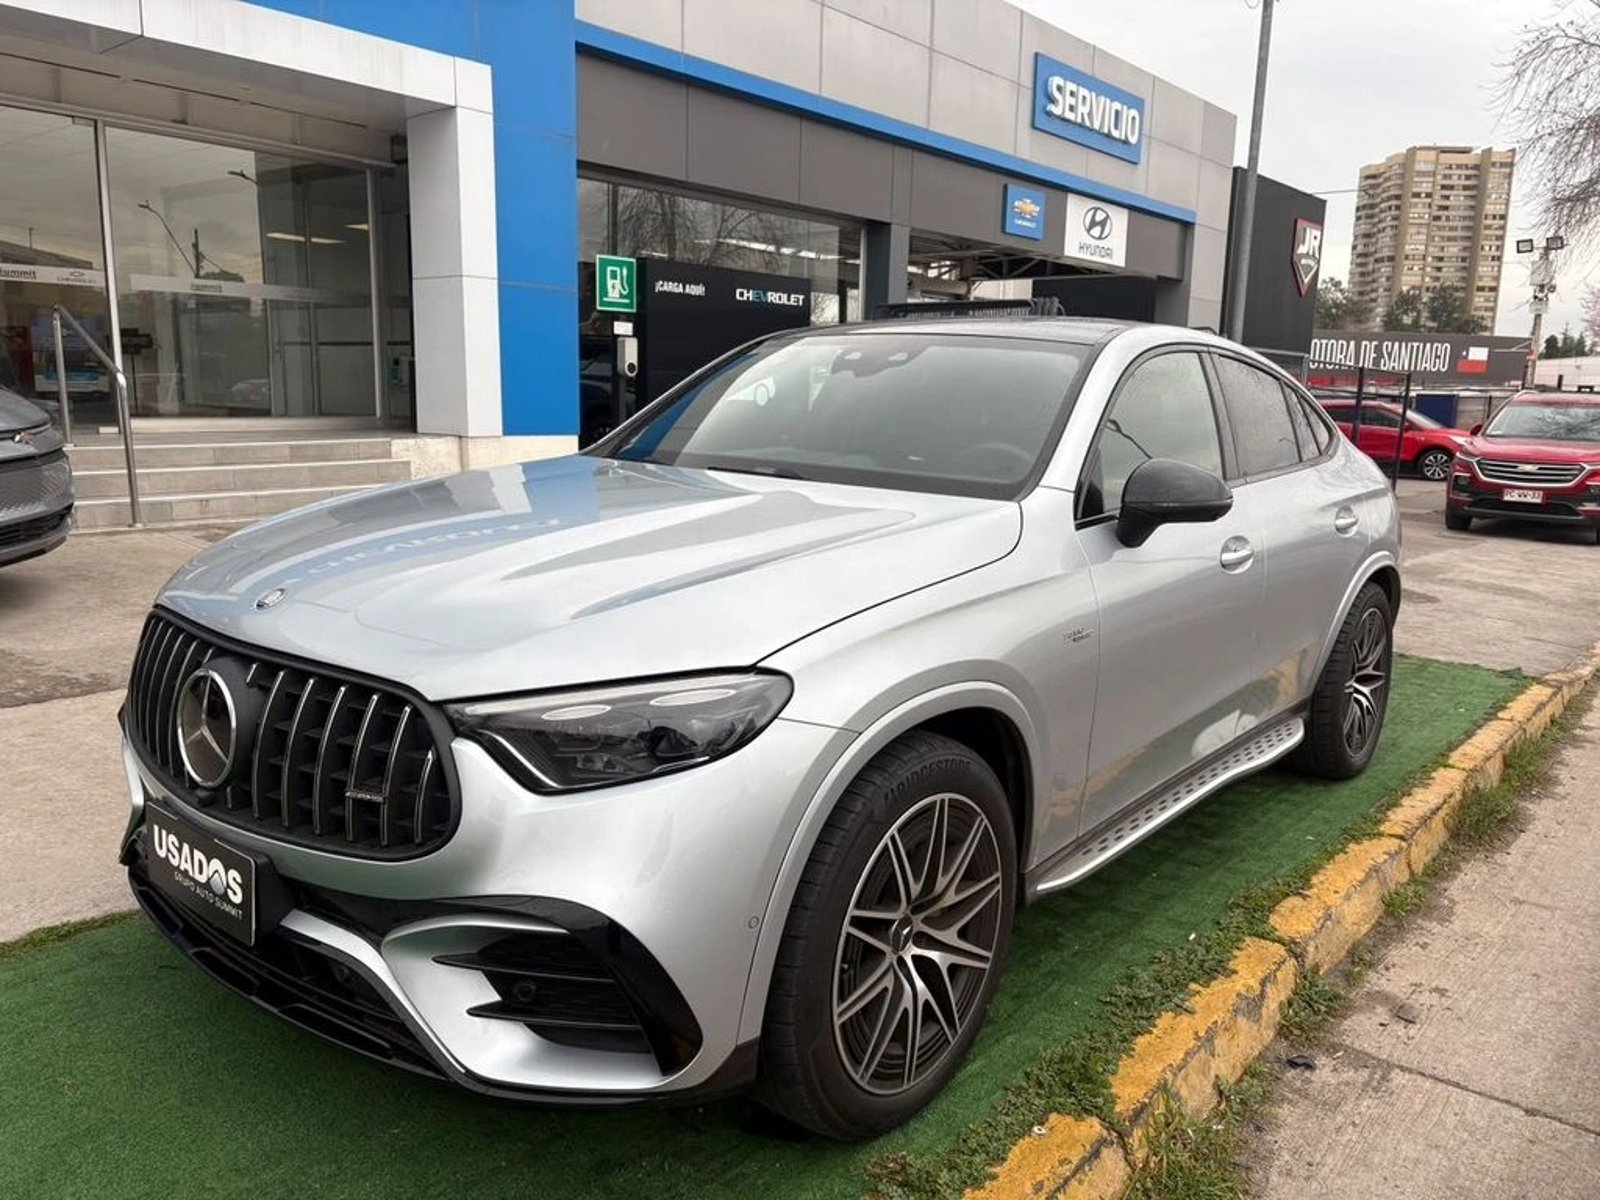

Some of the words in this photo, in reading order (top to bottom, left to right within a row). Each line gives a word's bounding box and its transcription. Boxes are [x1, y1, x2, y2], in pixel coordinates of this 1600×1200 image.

[1046, 75, 1140, 145] SERVICIO
[1078, 241, 1113, 260] HYUNDAI
[655, 280, 683, 294] ¡CARGA
[735, 288, 805, 306] CHEVROLET
[1359, 340, 1379, 369] DE
[1381, 340, 1451, 372] SANTIAGO
[153, 824, 243, 905] USADOS
